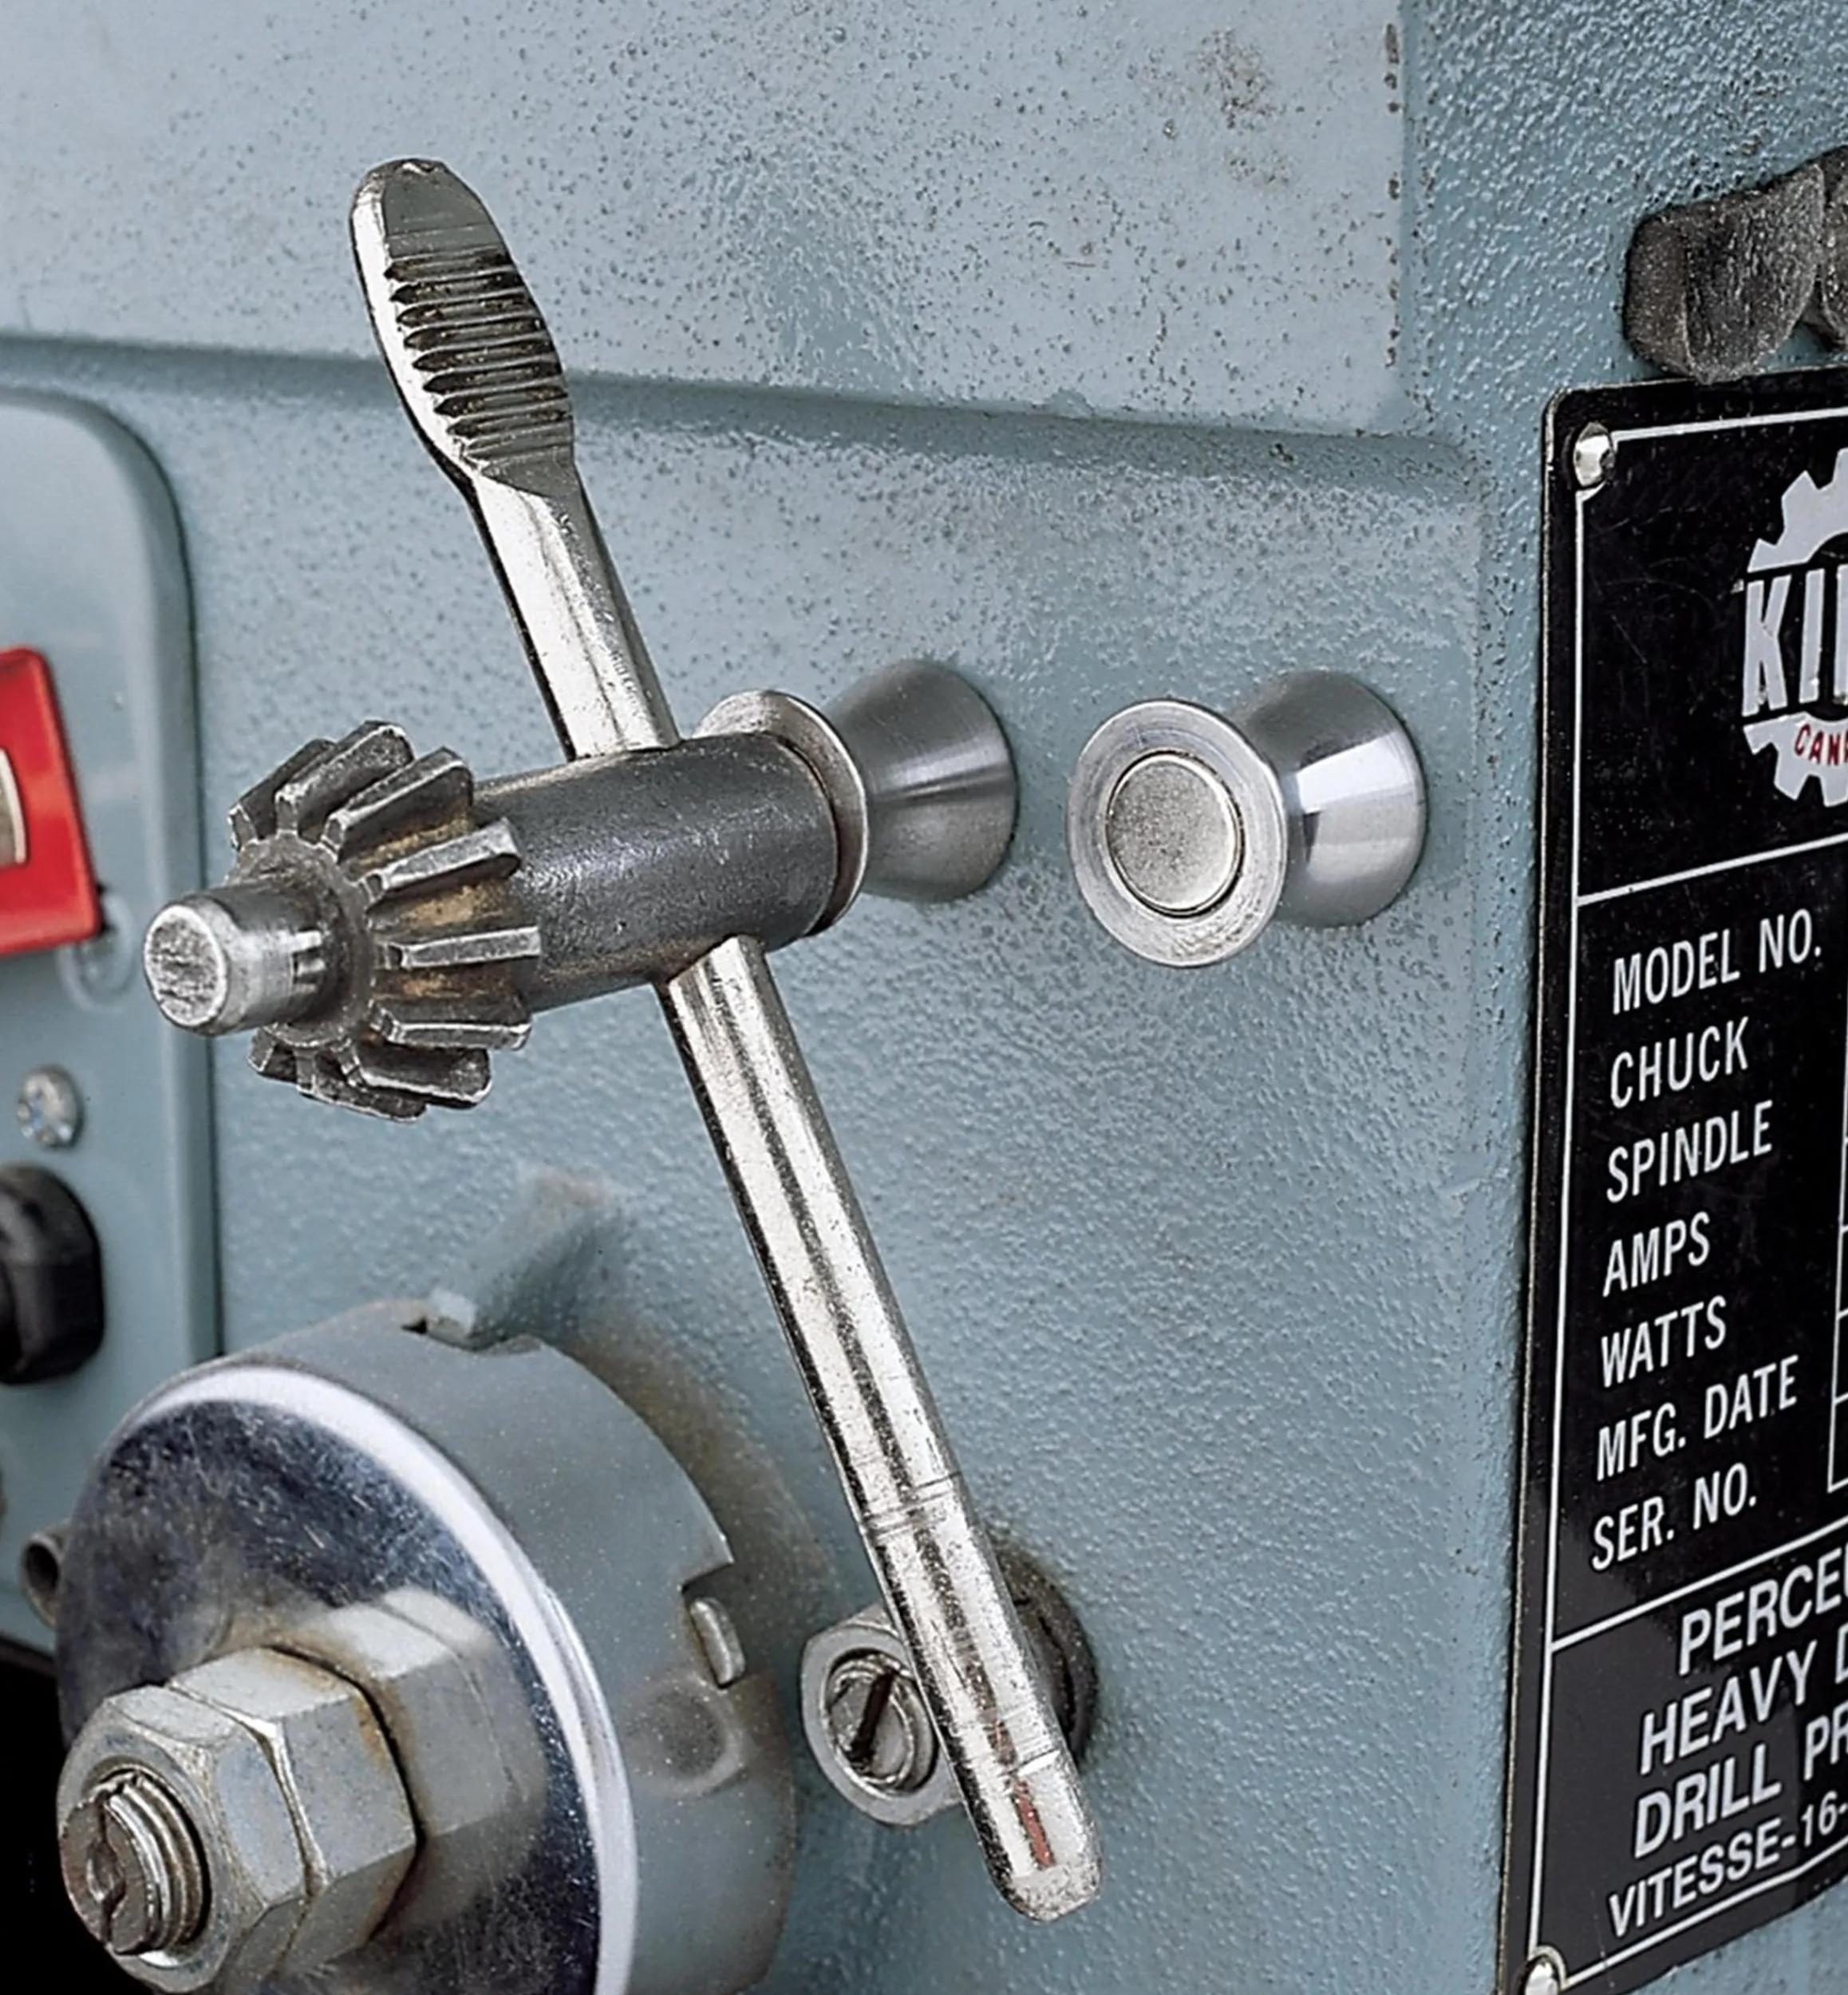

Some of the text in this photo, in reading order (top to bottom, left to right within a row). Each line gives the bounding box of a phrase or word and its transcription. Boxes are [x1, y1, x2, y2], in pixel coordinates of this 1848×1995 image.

[1794, 723, 1848, 766] CAN
[1613, 909, 1821, 1015] MODEL NO.
[1610, 1016, 1748, 1108] CHUCK
[1606, 1100, 1773, 1203] SPINDLE
[1602, 1211, 1710, 1298] AMPS
[1601, 1295, 1726, 1388] WATTS
[1597, 1354, 1799, 1481] MFG. DATE
[1592, 1463, 1756, 1570] SER. NO.
[1679, 1543, 1848, 1676] PERCE
[1641, 1640, 1817, 1775] HEAVY
[1634, 1744, 1782, 1859] DRILL
